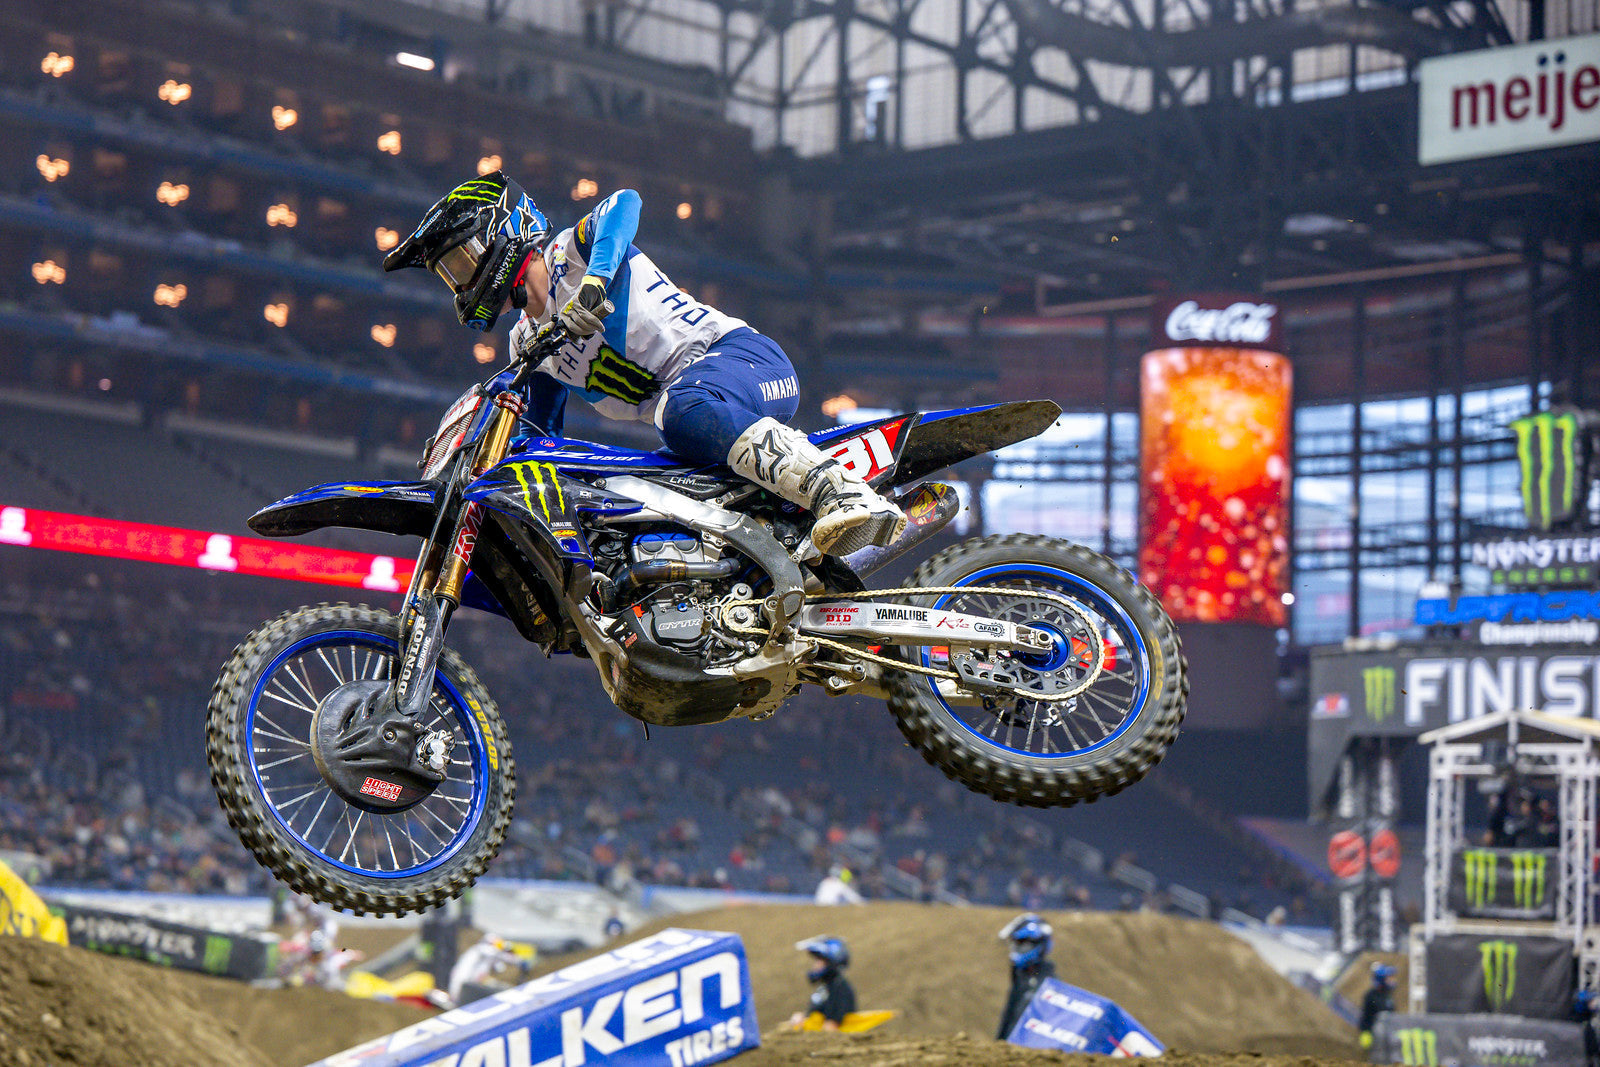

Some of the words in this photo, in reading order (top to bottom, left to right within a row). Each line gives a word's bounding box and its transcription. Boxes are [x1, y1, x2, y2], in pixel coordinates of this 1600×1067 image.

[492, 240, 518, 289] MONSTER
[646, 270, 710, 327] THO
[758, 375, 798, 402] YAMAHA
[875, 608, 928, 622] YAMALUBE
[397, 613, 427, 696] DUNLOP
[467, 698, 498, 771] DUNLOP
[361, 785, 398, 800] SPEED
[365, 778, 402, 793] LIGHT
[423, 951, 742, 1067] ALKEN
[664, 1014, 744, 1067] TIRES
